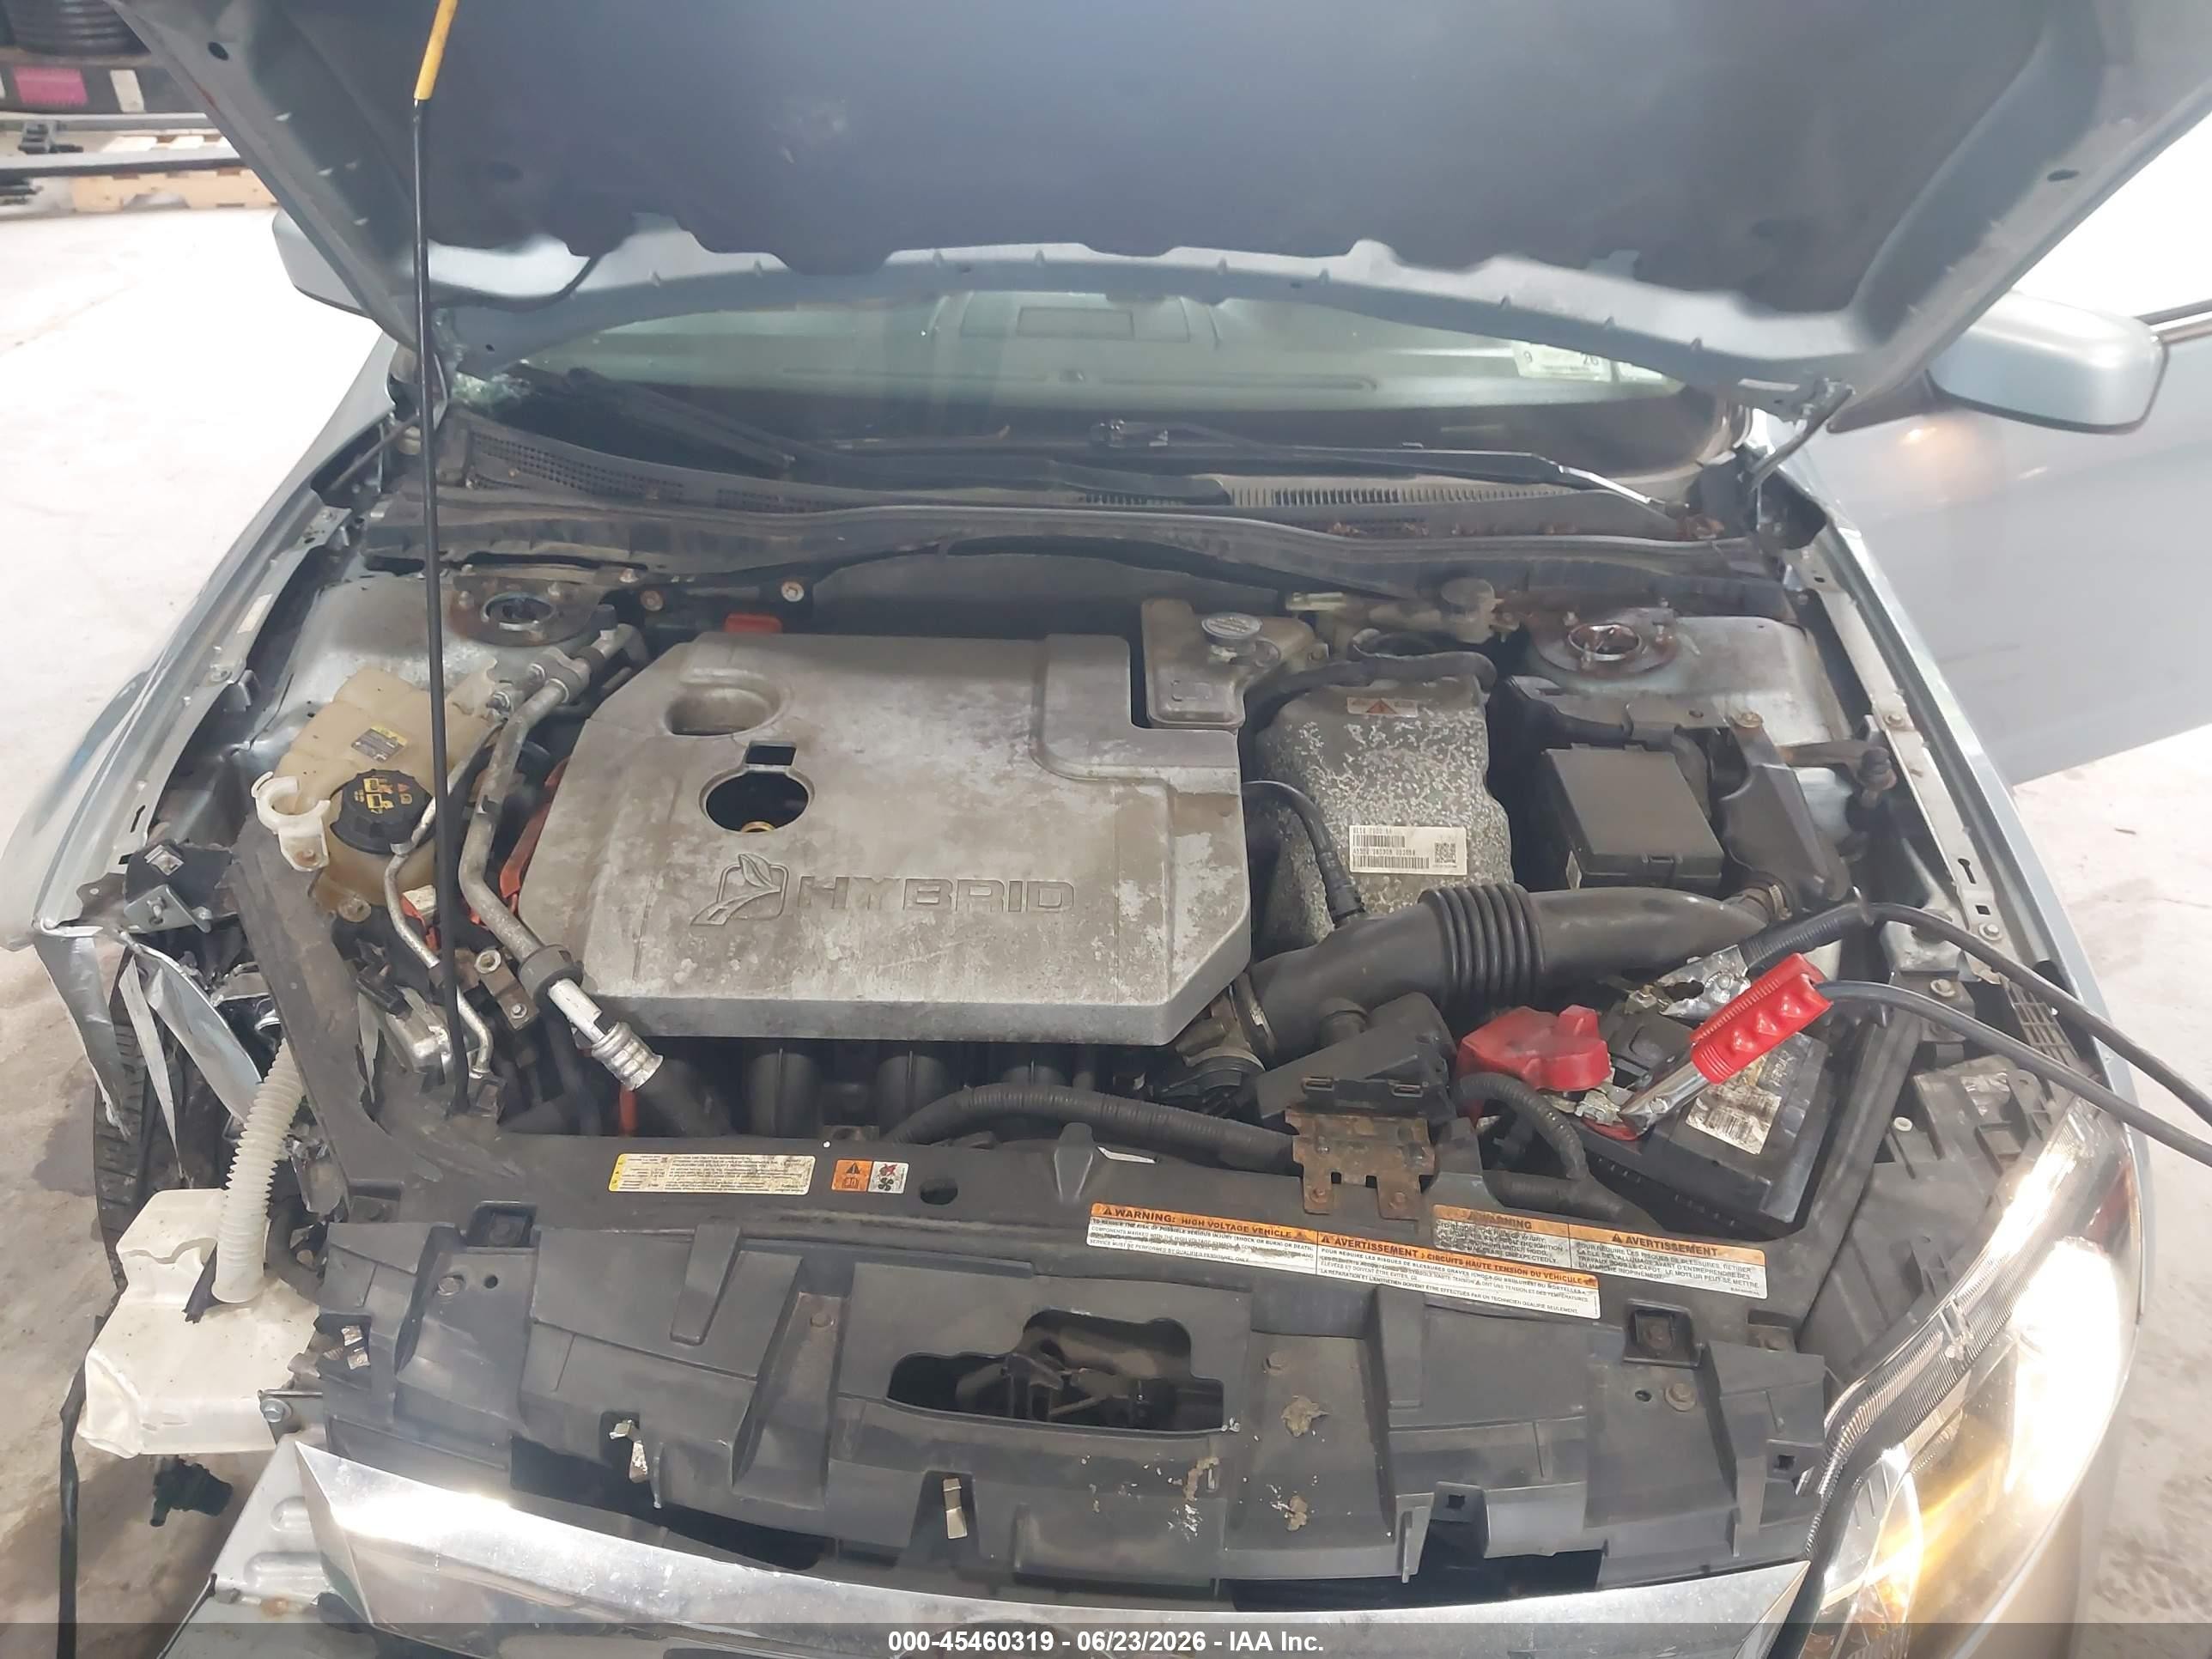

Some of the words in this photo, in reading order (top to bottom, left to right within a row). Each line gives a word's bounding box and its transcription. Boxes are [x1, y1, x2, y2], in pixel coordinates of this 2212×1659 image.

[798, 874, 1075, 914] HYBRID
[1091, 1225, 1126, 1234] COMPONENTS
[1114, 1207, 1176, 1223] WARNING:
[1181, 1217, 1204, 1226] HIGH
[1206, 1220, 1249, 1232] VOLTAGE
[1252, 1226, 1291, 1238] VEHICLE
[1134, 1243, 1166, 1253] PERFORMED
[1334, 1237, 1418, 1258] AVERTISSEMENT
[1426, 1253, 1462, 1265] CIRCUITS
[1465, 1259, 1491, 1269] HAUTE
[1494, 1263, 1527, 1275] TENSION
[1530, 1269, 1540, 1278] DU
[1626, 1235, 1717, 1257] AVERTISSEMENT
[1376, 1256, 1401, 1265] RISQUES
[1446, 1267, 1469, 1276] GRAVES
[1578, 1255, 1607, 1265] TRAVAUX
[1674, 1270, 1702, 1279] MOTEUR
